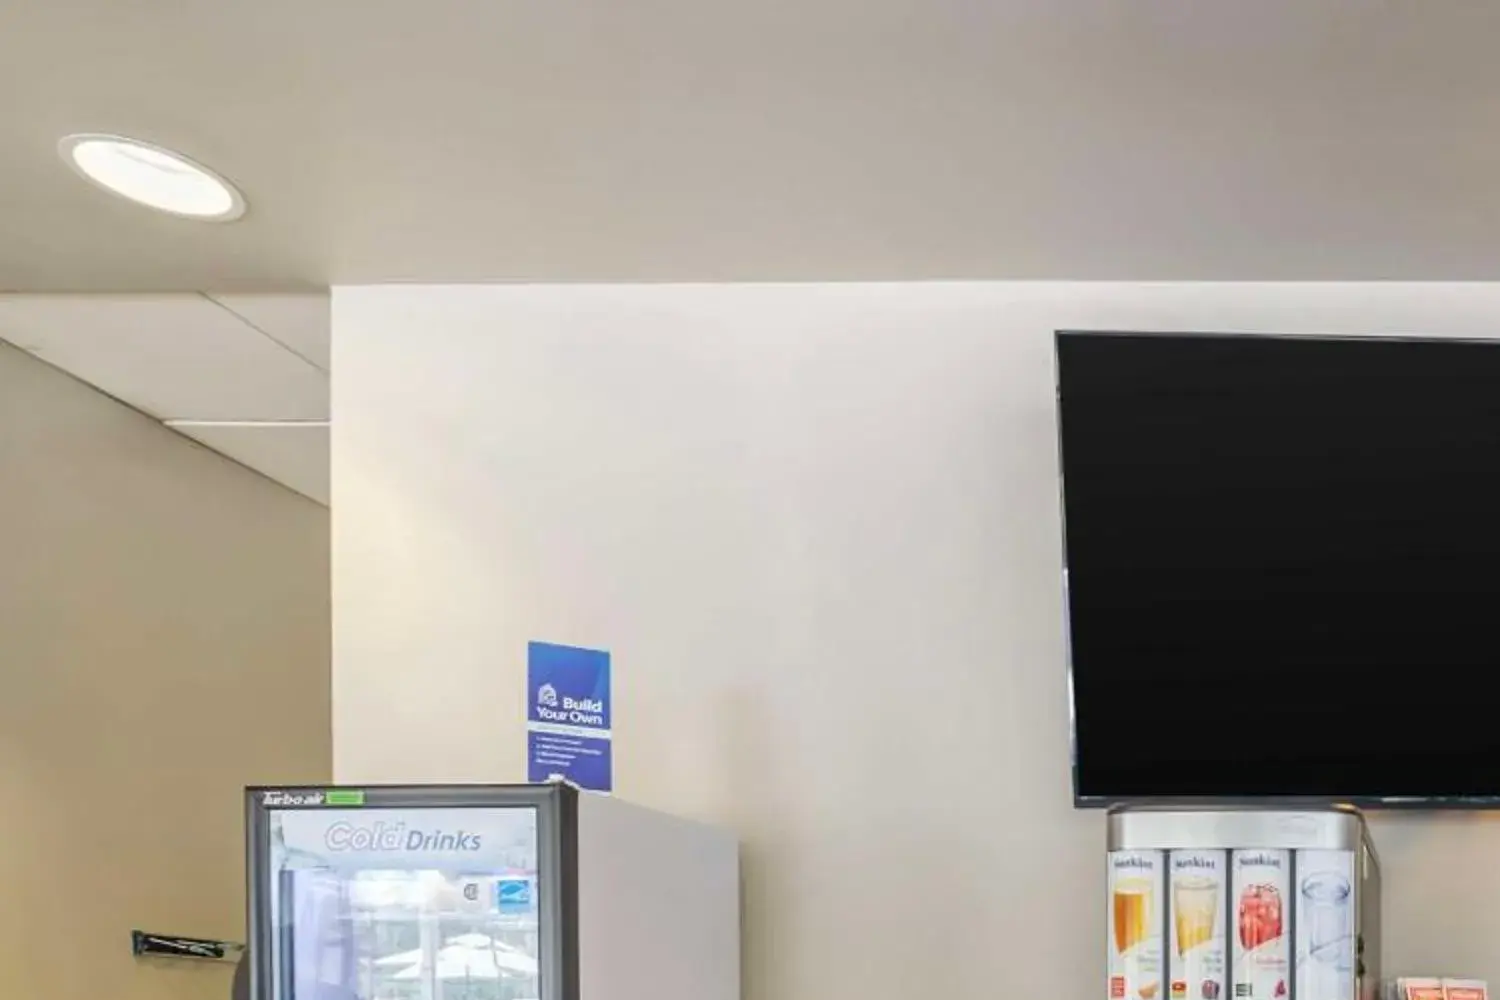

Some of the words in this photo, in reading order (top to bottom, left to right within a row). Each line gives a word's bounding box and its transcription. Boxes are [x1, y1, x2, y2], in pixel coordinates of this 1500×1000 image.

[563, 697, 602, 713] Build
[537, 706, 567, 720] Your
[570, 711, 603, 725] Own
[325, 820, 403, 851] Cold
[406, 830, 481, 850] Drinks
